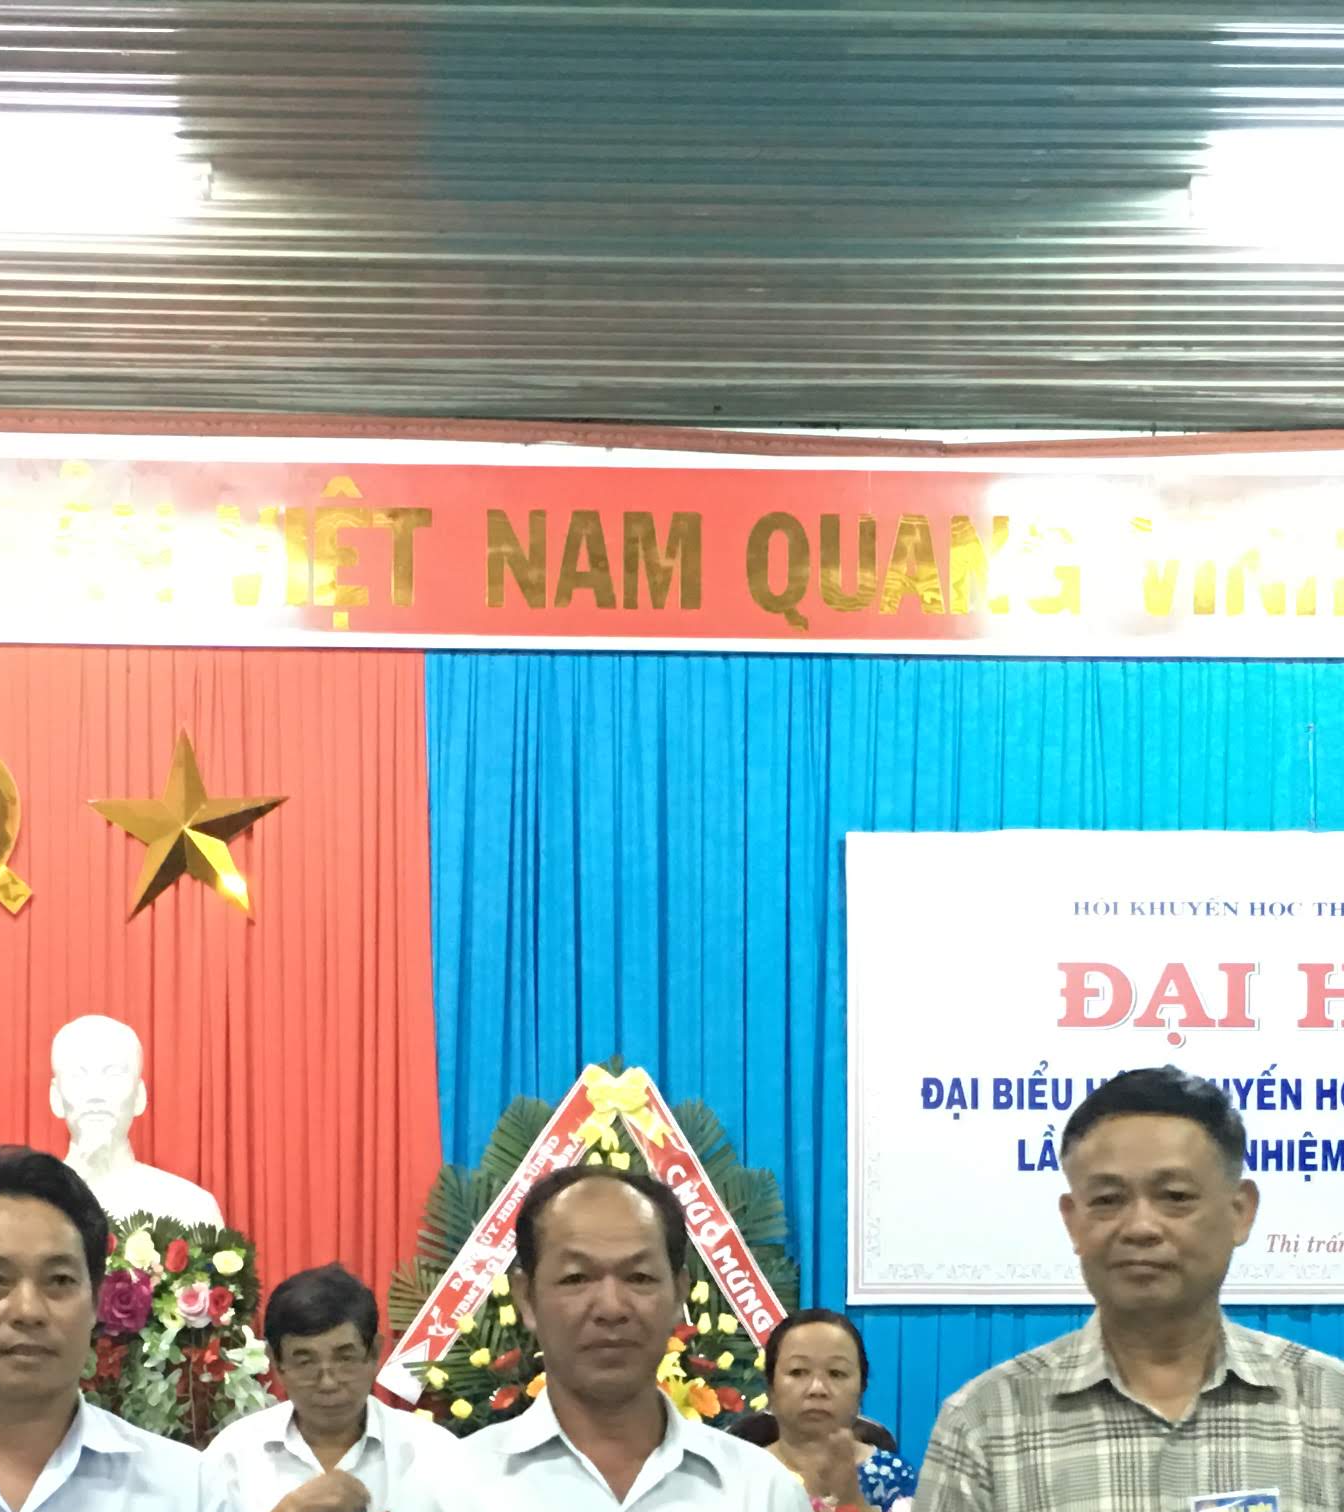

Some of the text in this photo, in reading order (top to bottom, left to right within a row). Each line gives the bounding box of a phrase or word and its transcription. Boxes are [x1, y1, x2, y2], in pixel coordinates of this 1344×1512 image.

[485, 508, 702, 611] NAM
[1057, 962, 1260, 1048] ĐẠI
[921, 1077, 978, 1120] ĐẠI
[993, 1060, 1073, 1111] BIỂU
[1017, 1125, 1060, 1171] LẦ
[1266, 1234, 1300, 1257] Thị
[712, 1245, 774, 1333] MỪNG
